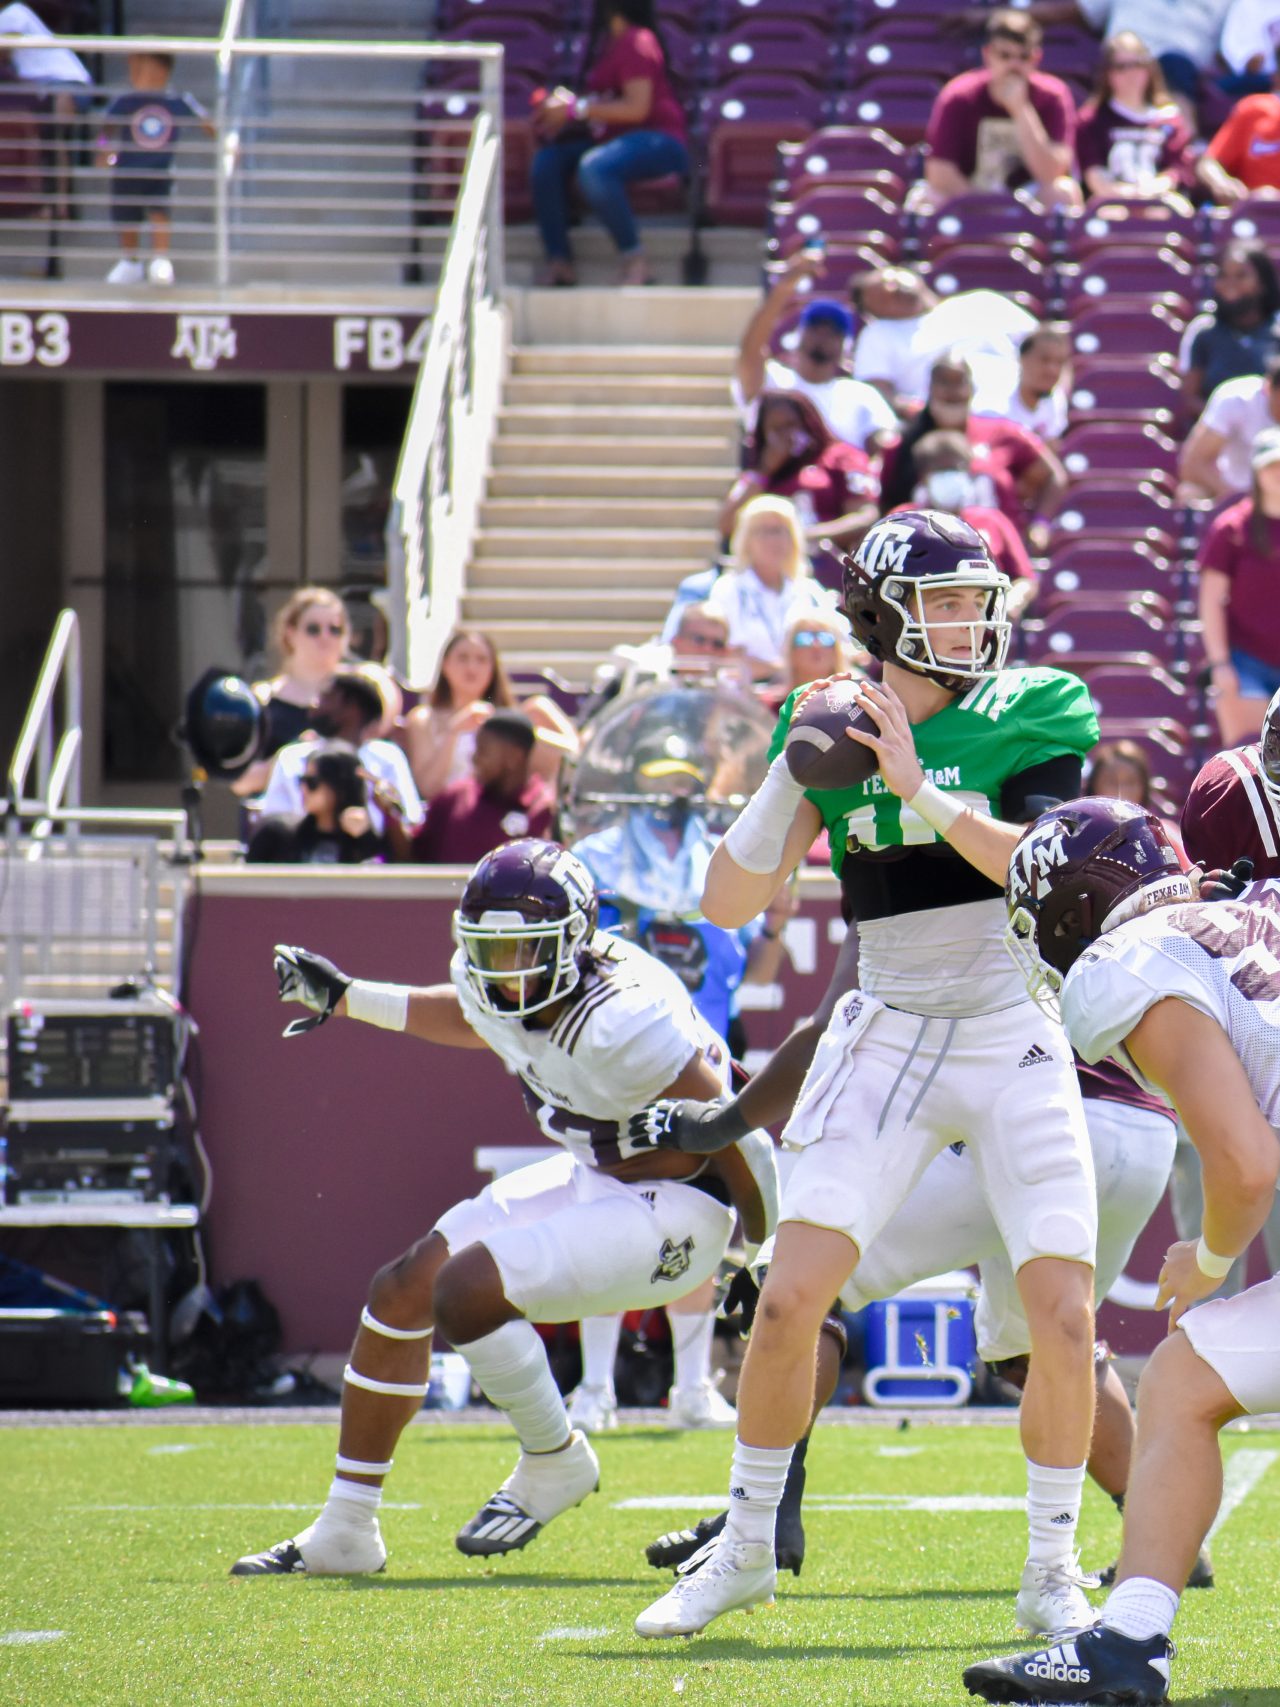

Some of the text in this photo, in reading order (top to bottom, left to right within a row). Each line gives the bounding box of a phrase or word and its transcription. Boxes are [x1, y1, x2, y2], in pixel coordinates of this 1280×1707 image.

[1146, 885, 1178, 905] TEXAS
[1018, 1054, 1053, 1069] adidas
[1024, 1661, 1091, 1683] adidas
